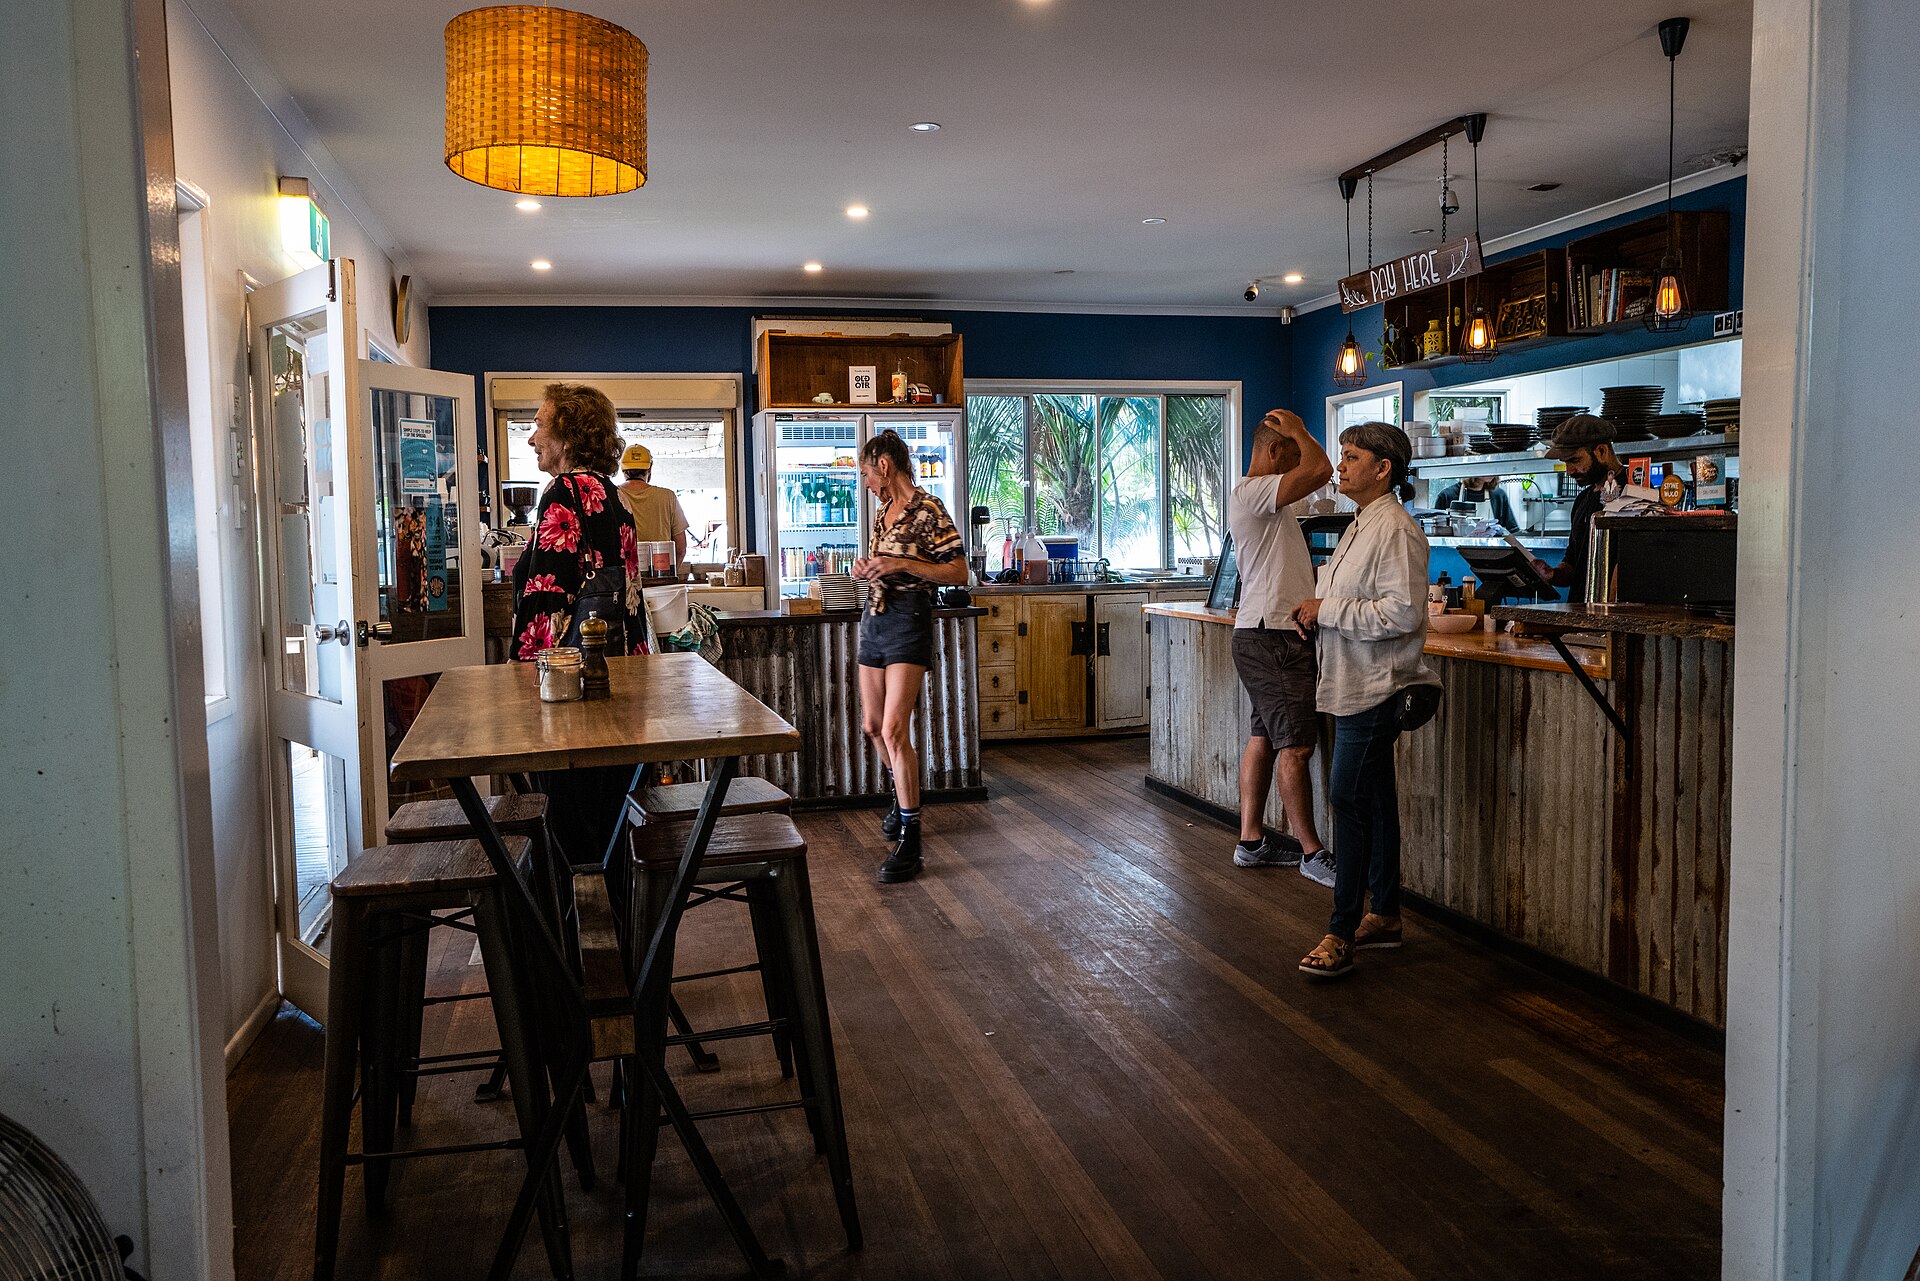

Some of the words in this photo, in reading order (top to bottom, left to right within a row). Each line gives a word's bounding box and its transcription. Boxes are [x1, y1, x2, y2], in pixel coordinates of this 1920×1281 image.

[1369, 263, 1397, 303] PAY
[1401, 249, 1441, 292] HERE
[1663, 482, 1679, 490] STONE
[1663, 490, 1679, 498] WOOD
